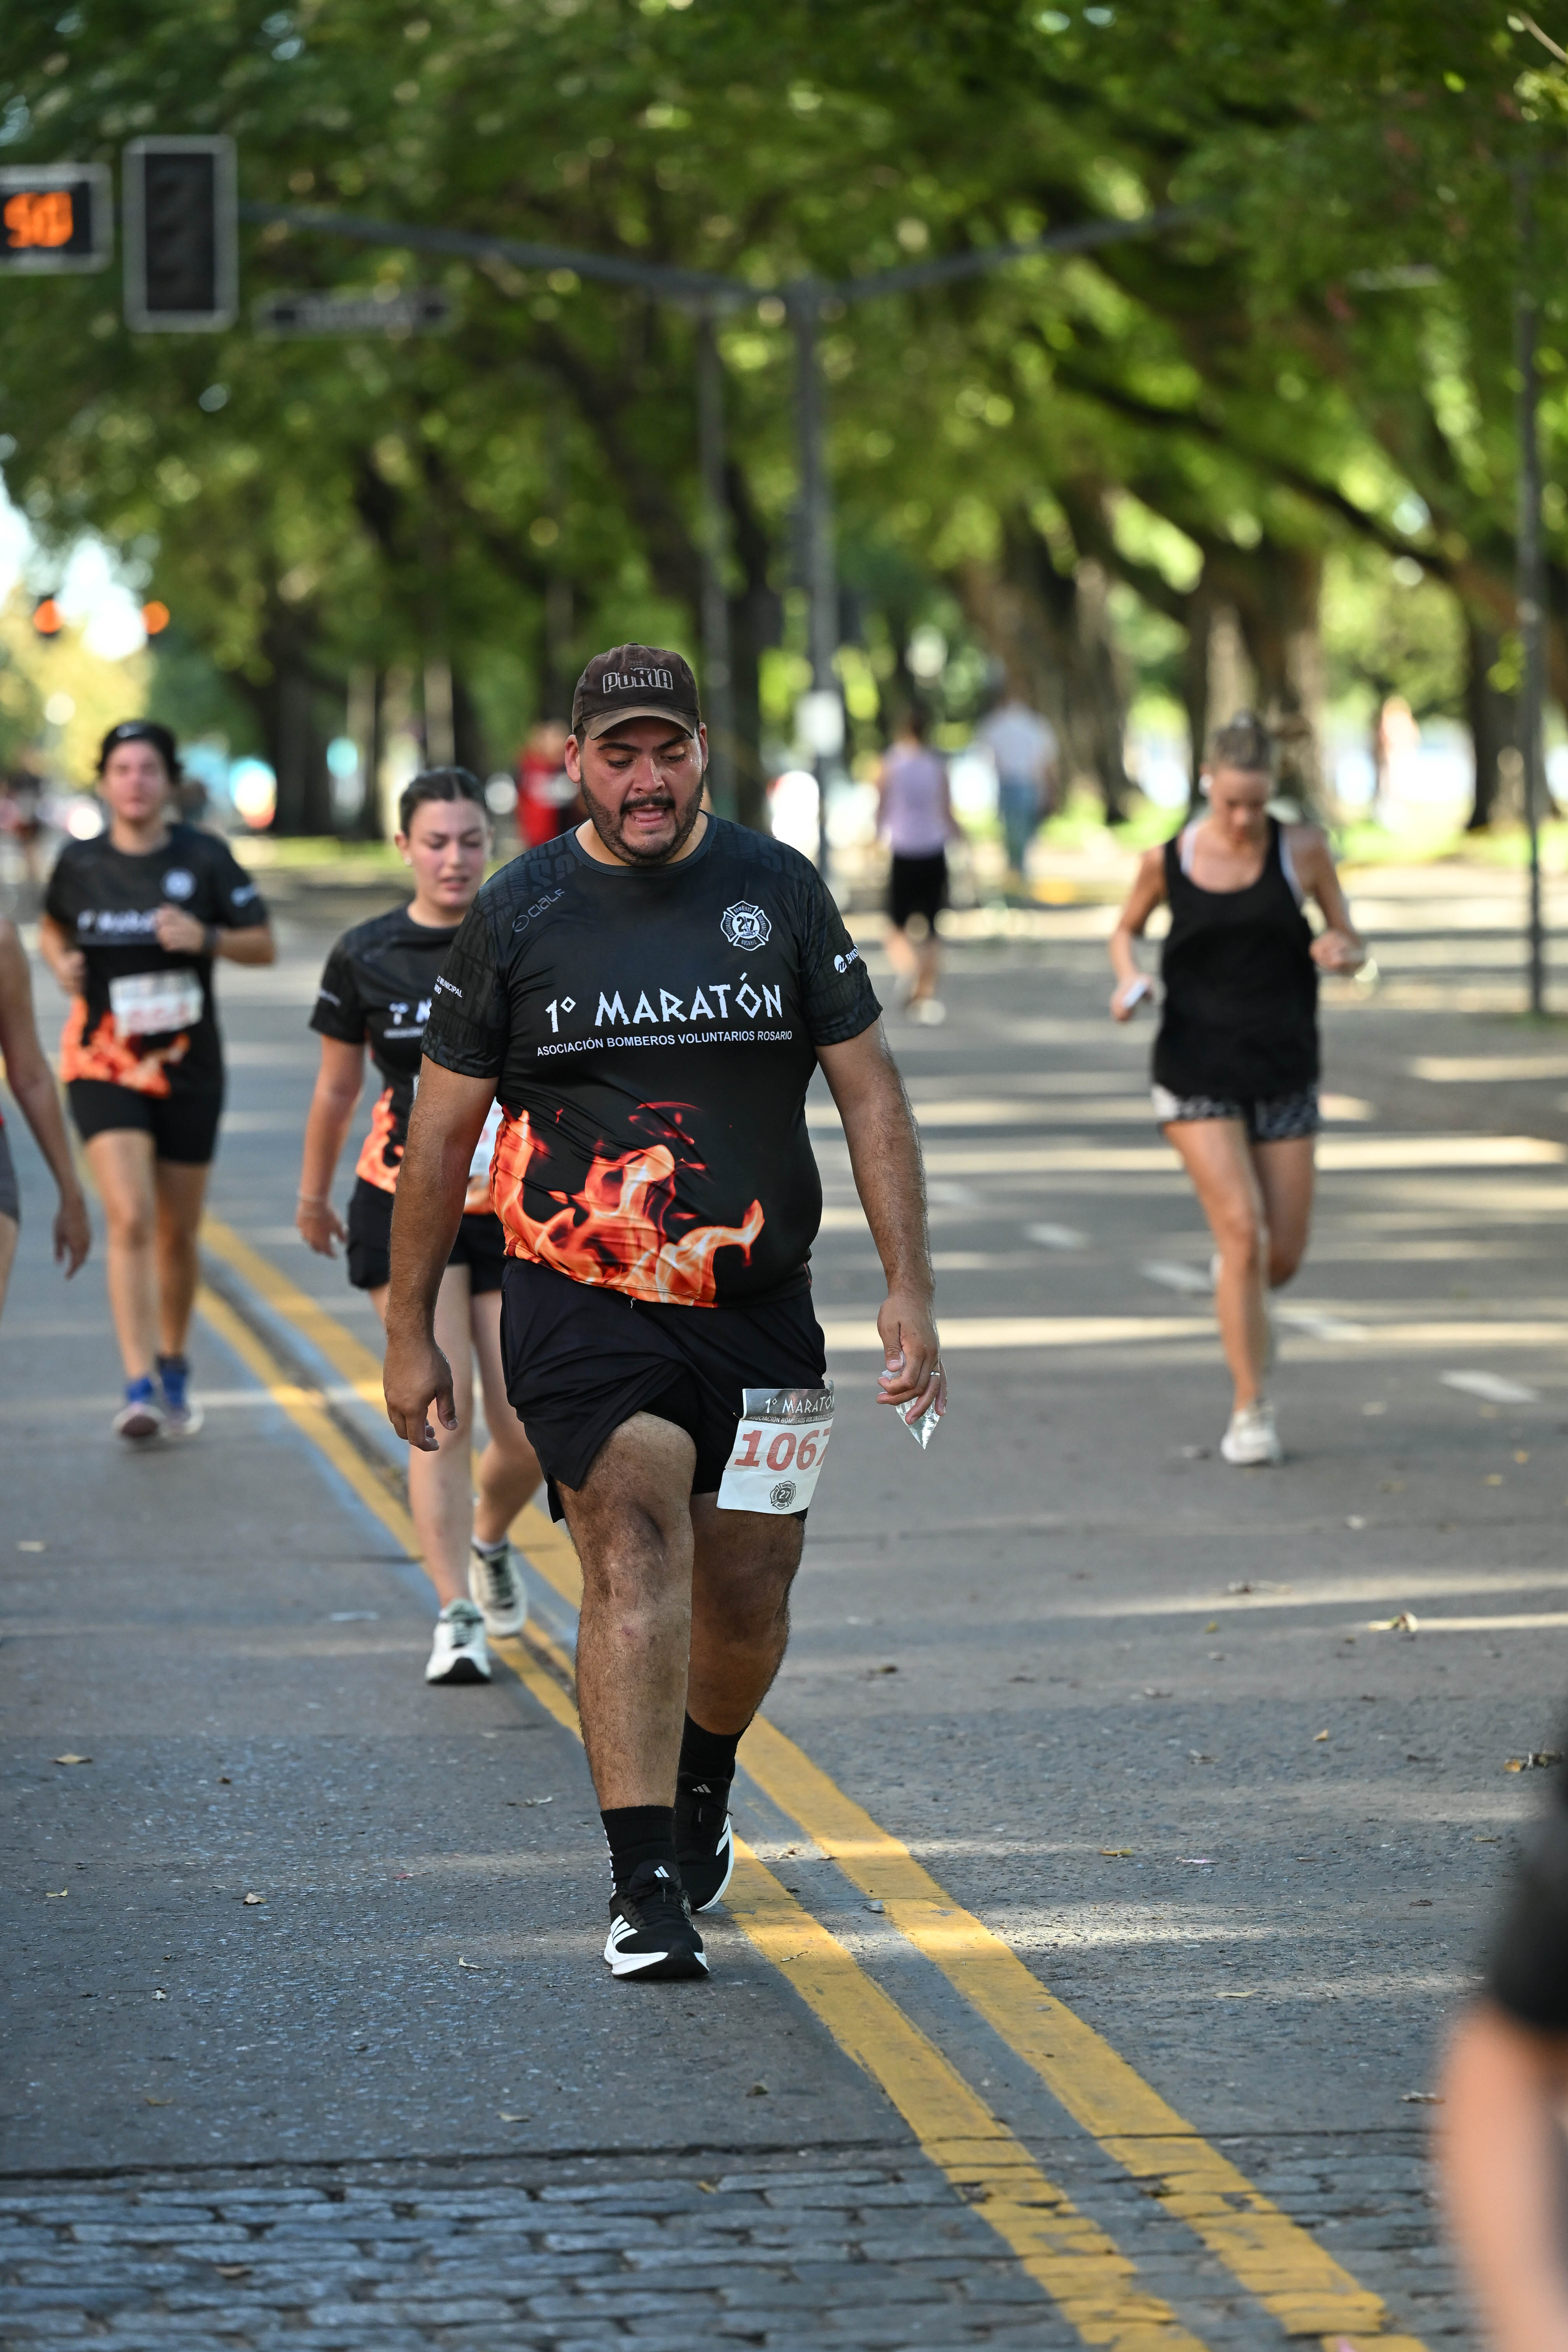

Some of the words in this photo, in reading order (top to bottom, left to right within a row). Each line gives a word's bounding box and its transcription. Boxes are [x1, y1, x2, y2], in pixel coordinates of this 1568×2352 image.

[733, 905, 752, 914] BOMBEROS
[737, 916, 755, 933] 27
[439, 977, 462, 998] MUNICIPAL
[545, 996, 576, 1032] 1°
[595, 972, 782, 1026] MARATÓN
[537, 1037, 604, 1056] ASOCIACIÓN
[607, 1035, 675, 1047] BOMBEROS
[678, 1031, 755, 1044] VOLUNTARIOS
[758, 1031, 792, 1041] ROSARIO
[779, 1490, 790, 1499] 27
